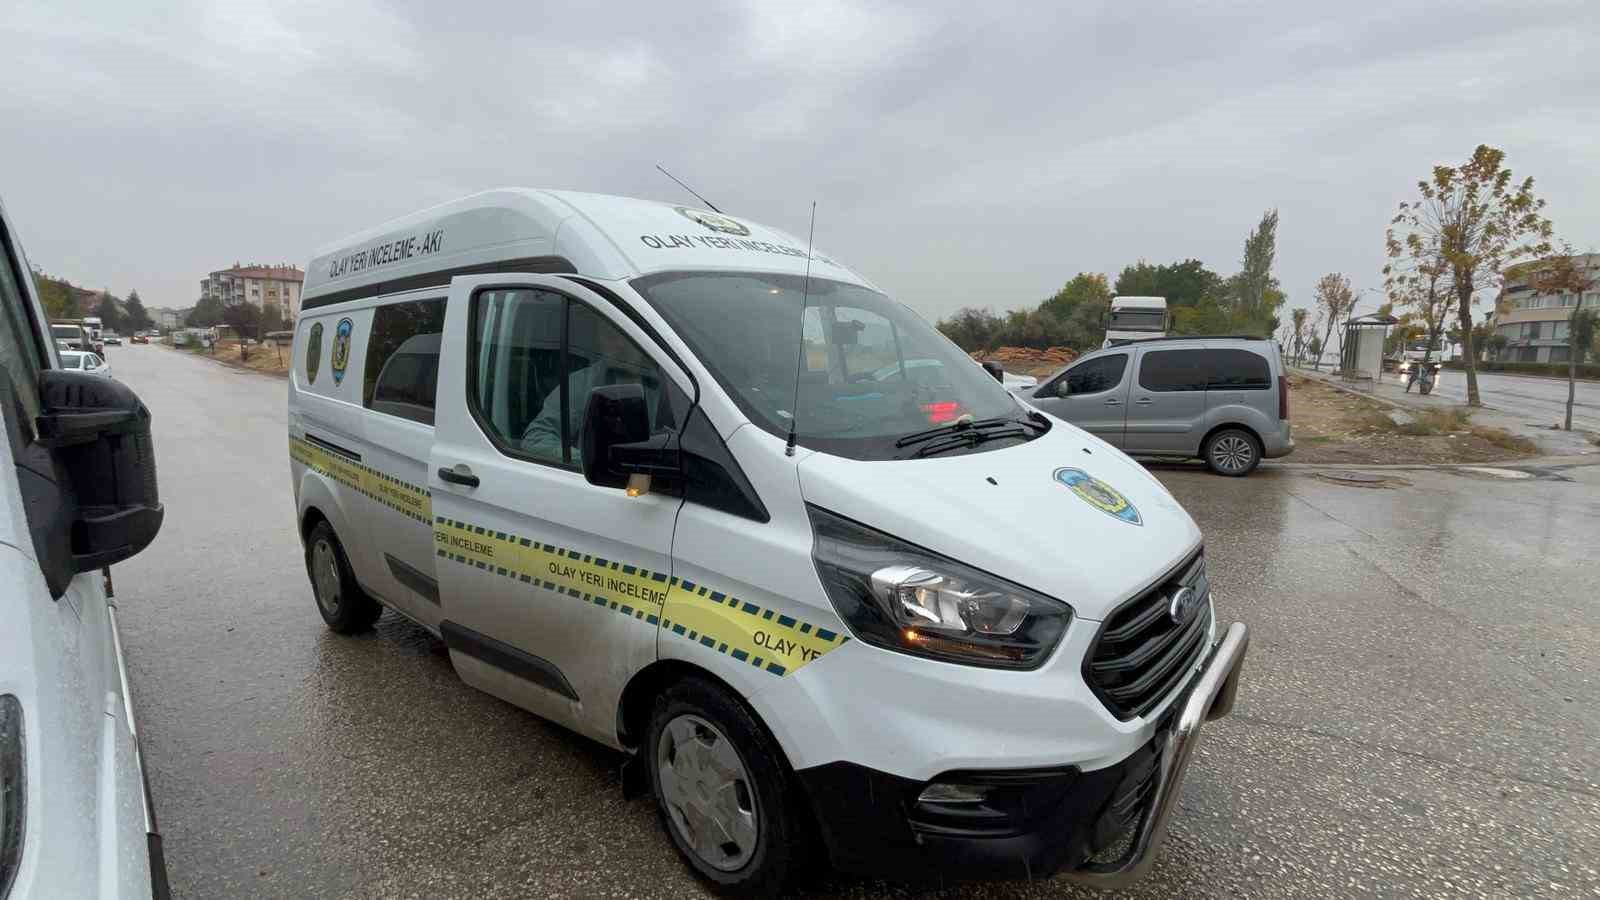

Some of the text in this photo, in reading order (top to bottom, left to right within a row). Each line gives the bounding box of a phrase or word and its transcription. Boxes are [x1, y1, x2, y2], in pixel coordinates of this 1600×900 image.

[640, 235, 696, 249] OLAY
[329, 256, 349, 278] OLAY
[549, 562, 577, 580] OLAY
[753, 631, 797, 657] OLAY
